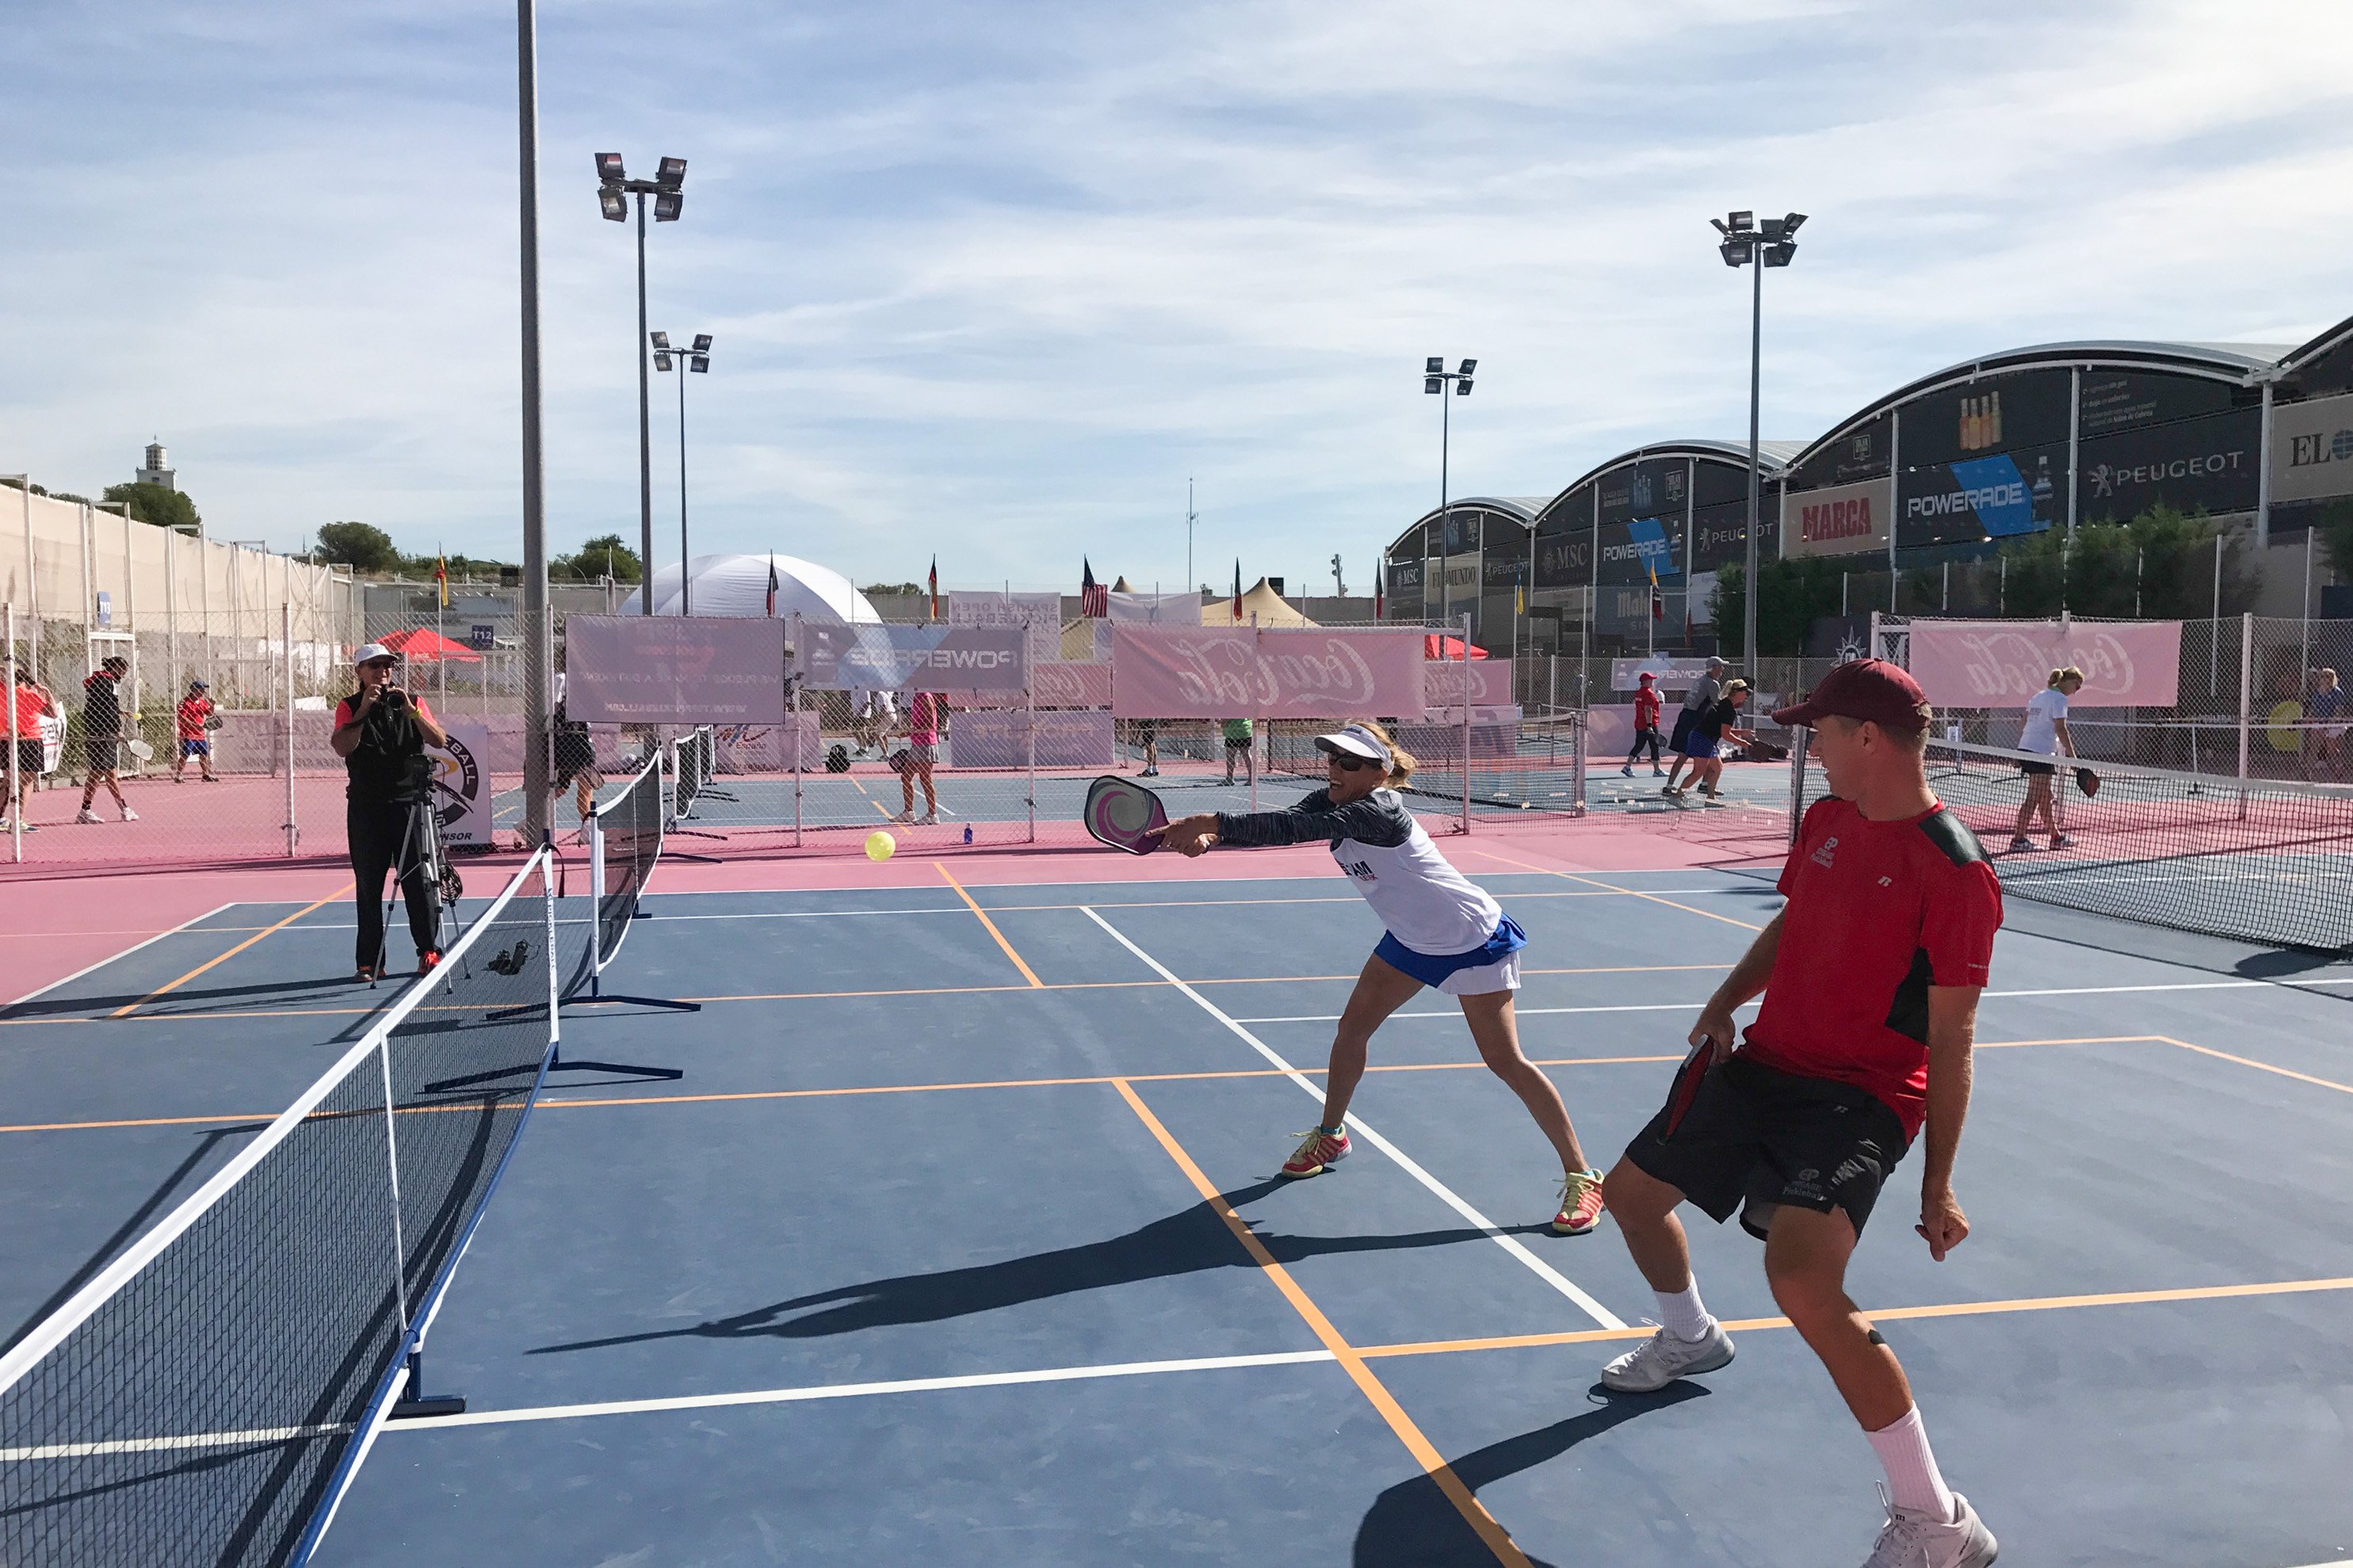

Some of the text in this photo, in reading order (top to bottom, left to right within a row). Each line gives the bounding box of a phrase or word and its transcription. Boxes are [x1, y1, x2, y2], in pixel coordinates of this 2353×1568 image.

[2290, 433, 2331, 467] EL
[2117, 451, 2244, 486] PEUGEOT
[1908, 483, 2023, 517] POWERADE
[1802, 498, 1871, 541] MARCA
[1712, 523, 1774, 544] PEUGOT
[1557, 543, 1587, 569] MSC
[1603, 539, 1667, 561] POWERADE
[1404, 568, 1419, 585] MSC
[1446, 567, 1476, 586] MUNDO
[100, 601, 110, 614] T13
